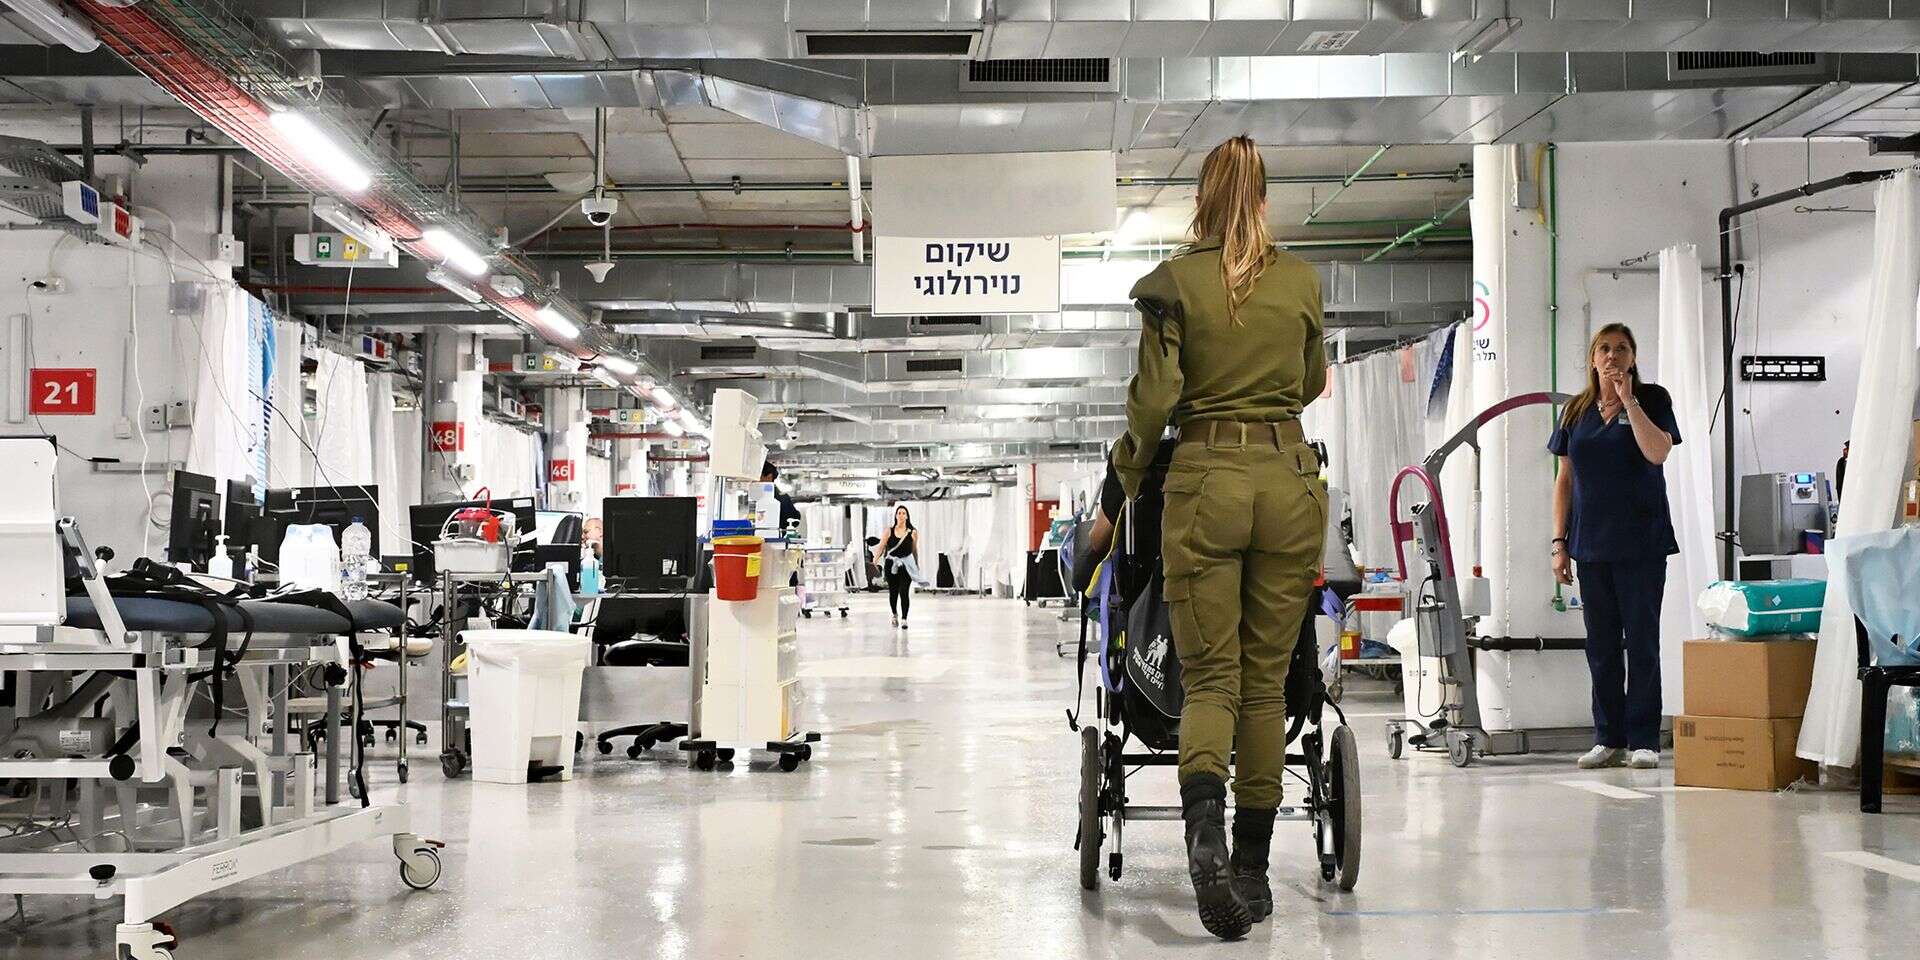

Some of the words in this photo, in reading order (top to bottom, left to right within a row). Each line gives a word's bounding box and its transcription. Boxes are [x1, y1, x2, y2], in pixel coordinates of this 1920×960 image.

[926, 243, 1010, 267] שיקום
[914, 269, 1021, 296] נוירולוגי
[43, 381, 78, 405] 21
[432, 430, 456, 446] 48
[552, 465, 569, 477] 46
